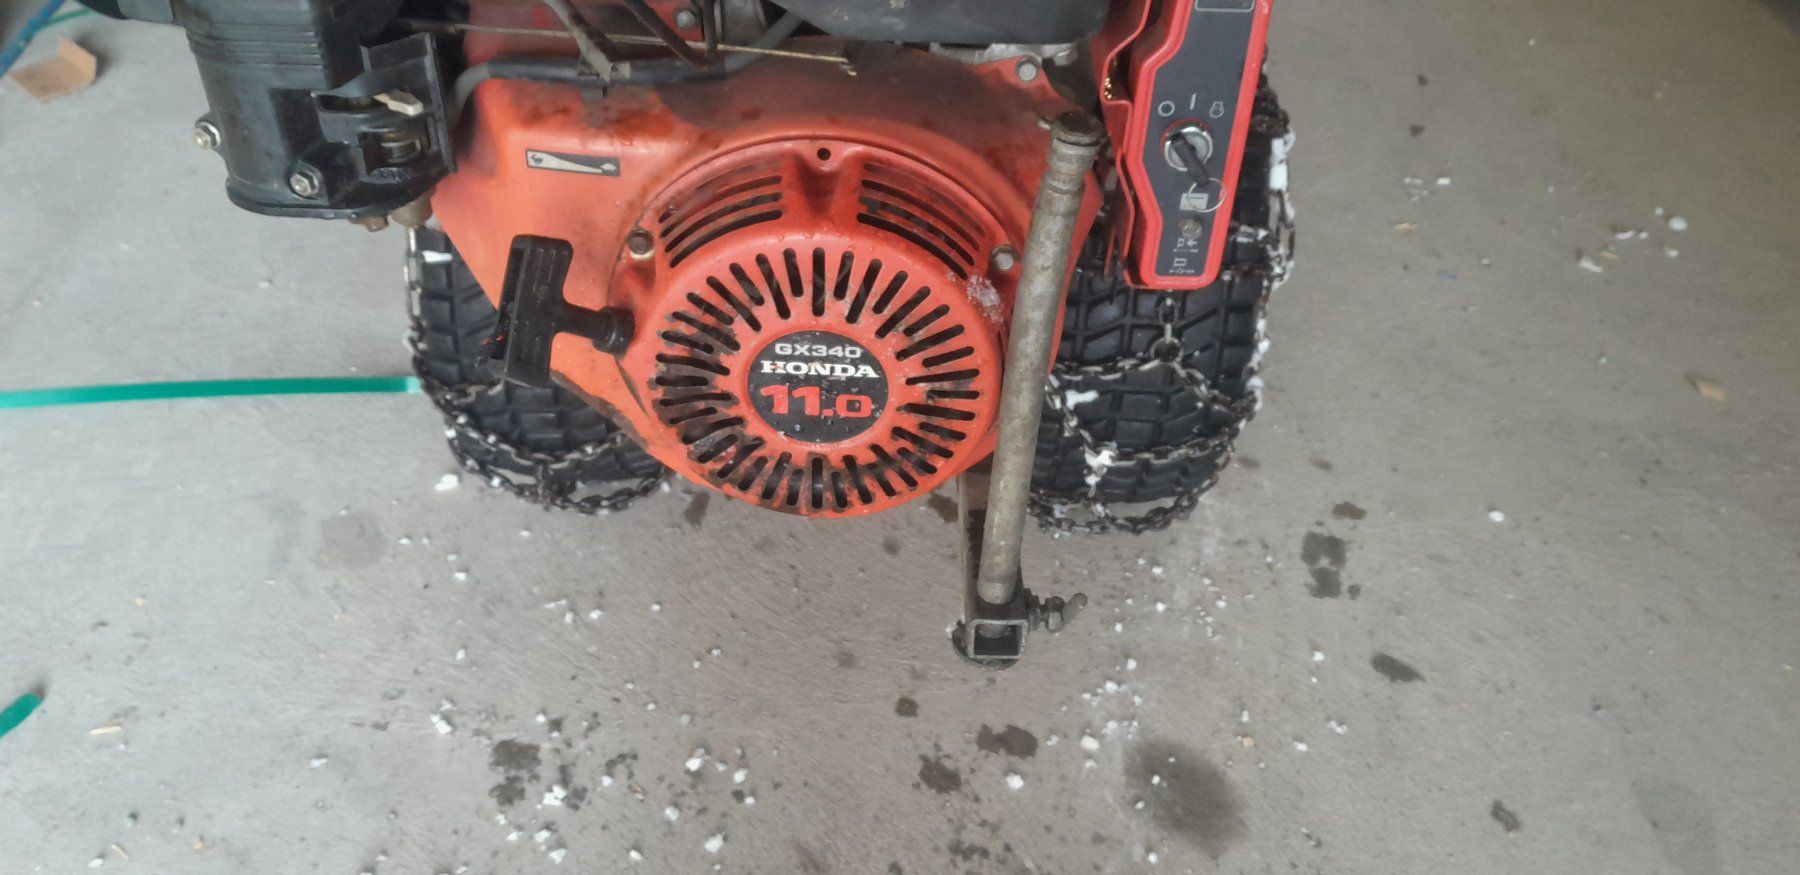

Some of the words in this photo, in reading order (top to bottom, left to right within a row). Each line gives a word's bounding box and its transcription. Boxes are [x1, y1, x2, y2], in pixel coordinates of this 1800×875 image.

[774, 343, 863, 359] GX340
[760, 360, 880, 378] HONDA
[760, 384, 873, 418] 11.0
